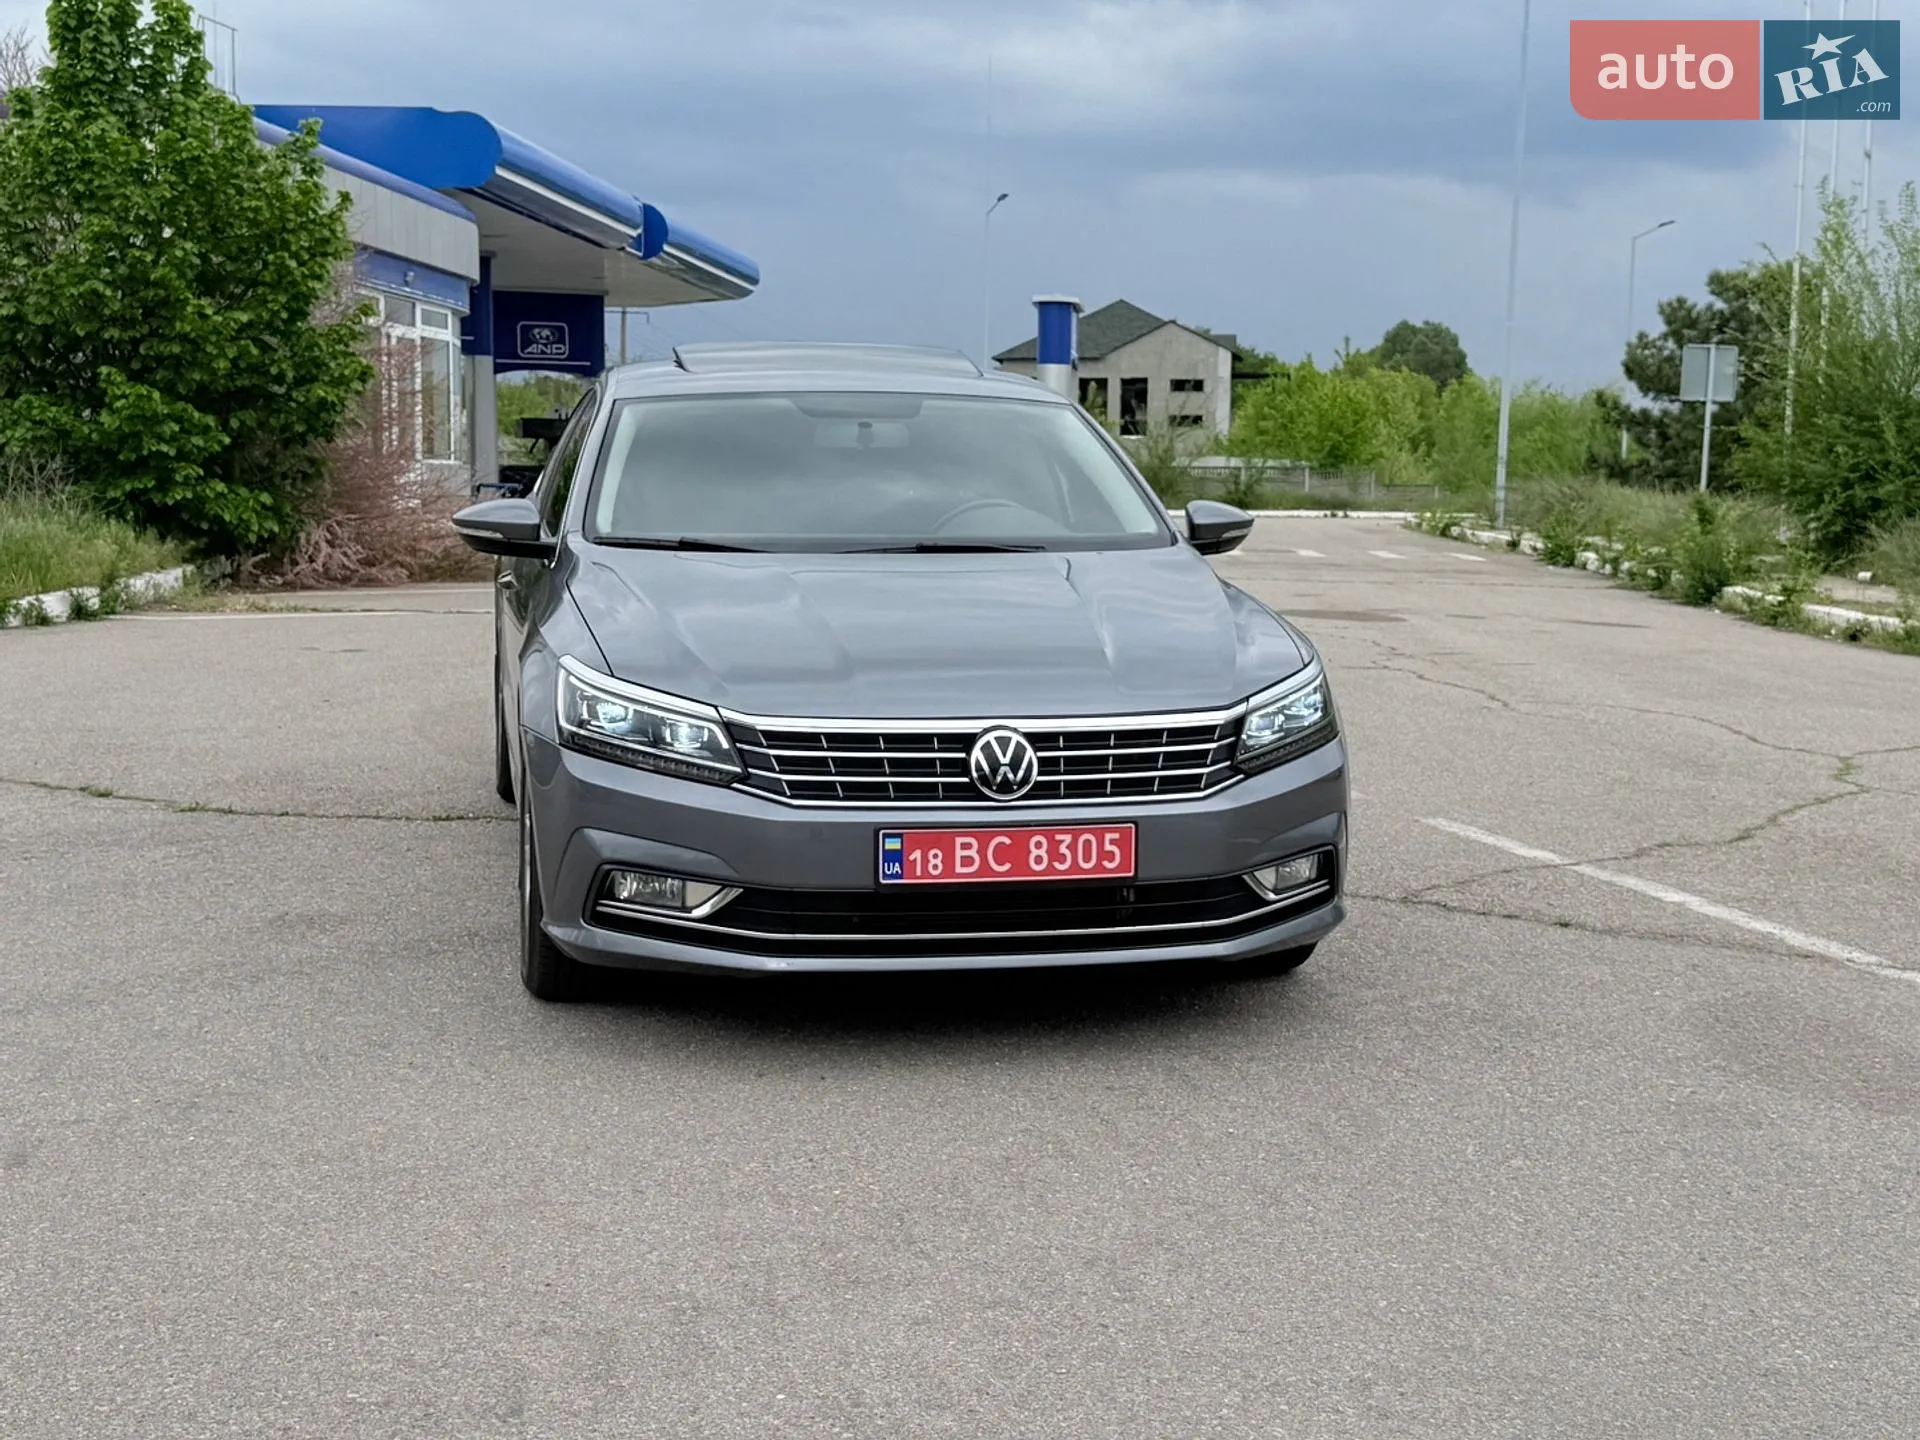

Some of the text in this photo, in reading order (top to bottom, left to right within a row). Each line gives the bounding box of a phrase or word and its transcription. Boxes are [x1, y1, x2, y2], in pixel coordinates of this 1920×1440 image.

[972, 730, 1037, 797] VW
[884, 862, 902, 875] UA
[907, 832, 1121, 876] 18 BC 8305
